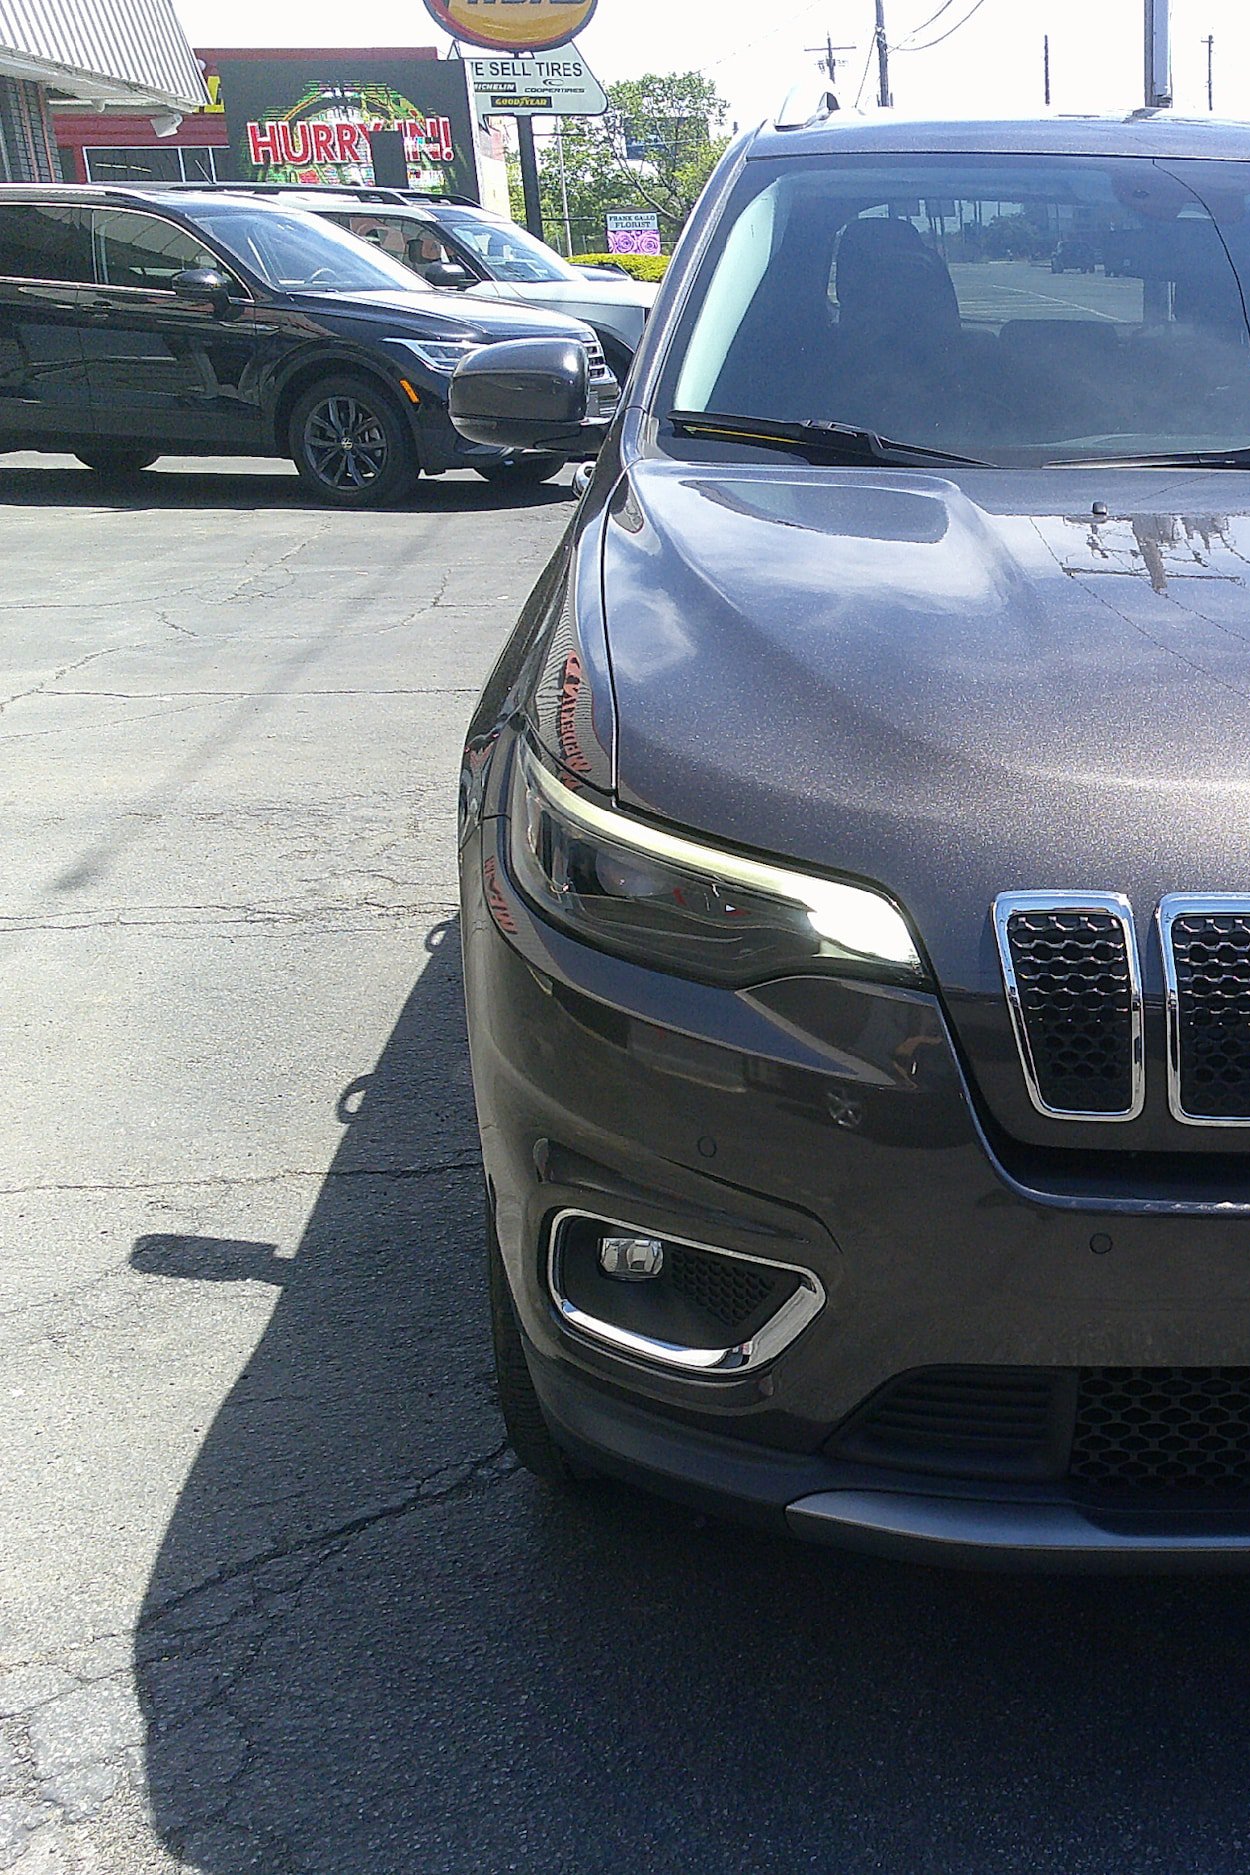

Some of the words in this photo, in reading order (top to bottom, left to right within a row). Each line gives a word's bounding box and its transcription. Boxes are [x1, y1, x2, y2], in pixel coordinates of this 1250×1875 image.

[471, 62, 484, 76] E
[489, 62, 531, 76] SELL
[535, 62, 582, 77] TIRES
[495, 96, 548, 107] GOODYEAR
[615, 221, 651, 229] FLORIST
